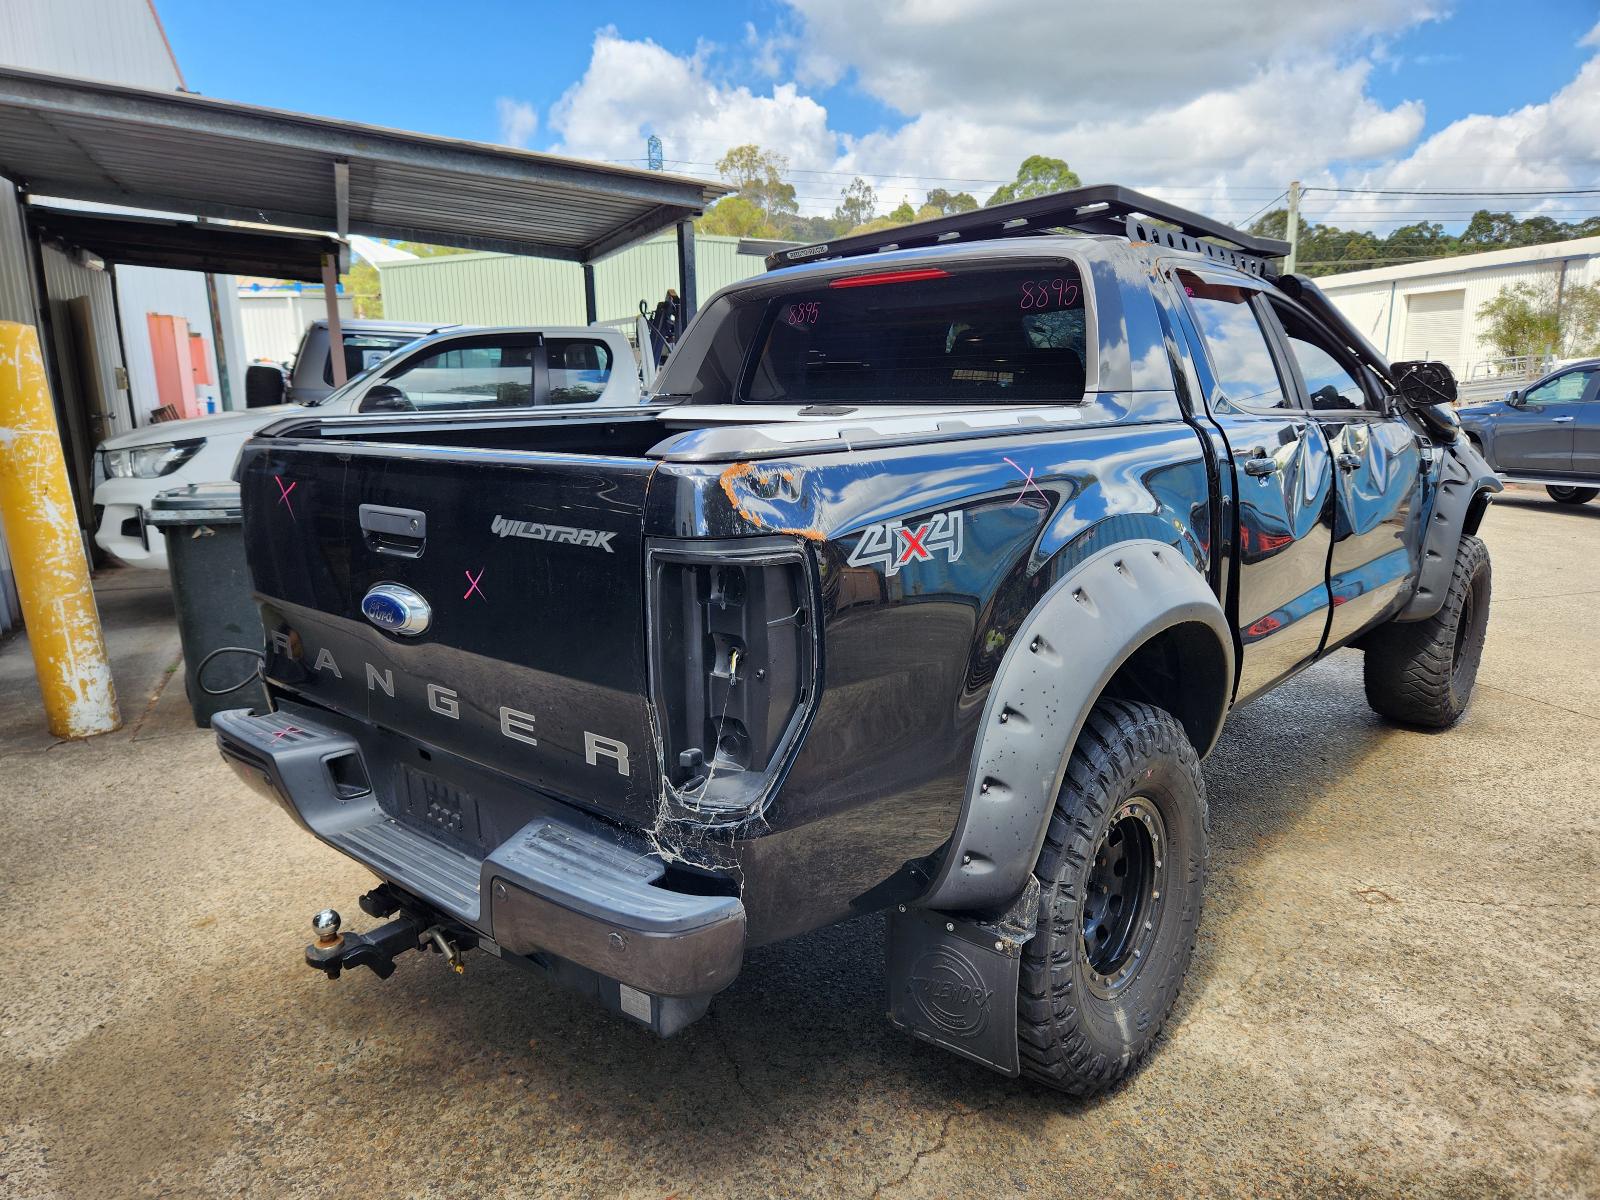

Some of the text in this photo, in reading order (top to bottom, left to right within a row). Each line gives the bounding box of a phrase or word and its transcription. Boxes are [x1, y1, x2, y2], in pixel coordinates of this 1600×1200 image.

[1019, 278, 1080, 309] 8895
[788, 301, 821, 325] 8895
[490, 514, 619, 553] WILDTRAK
[368, 600, 394, 623] Ford
[271, 630, 630, 777] RANGER
